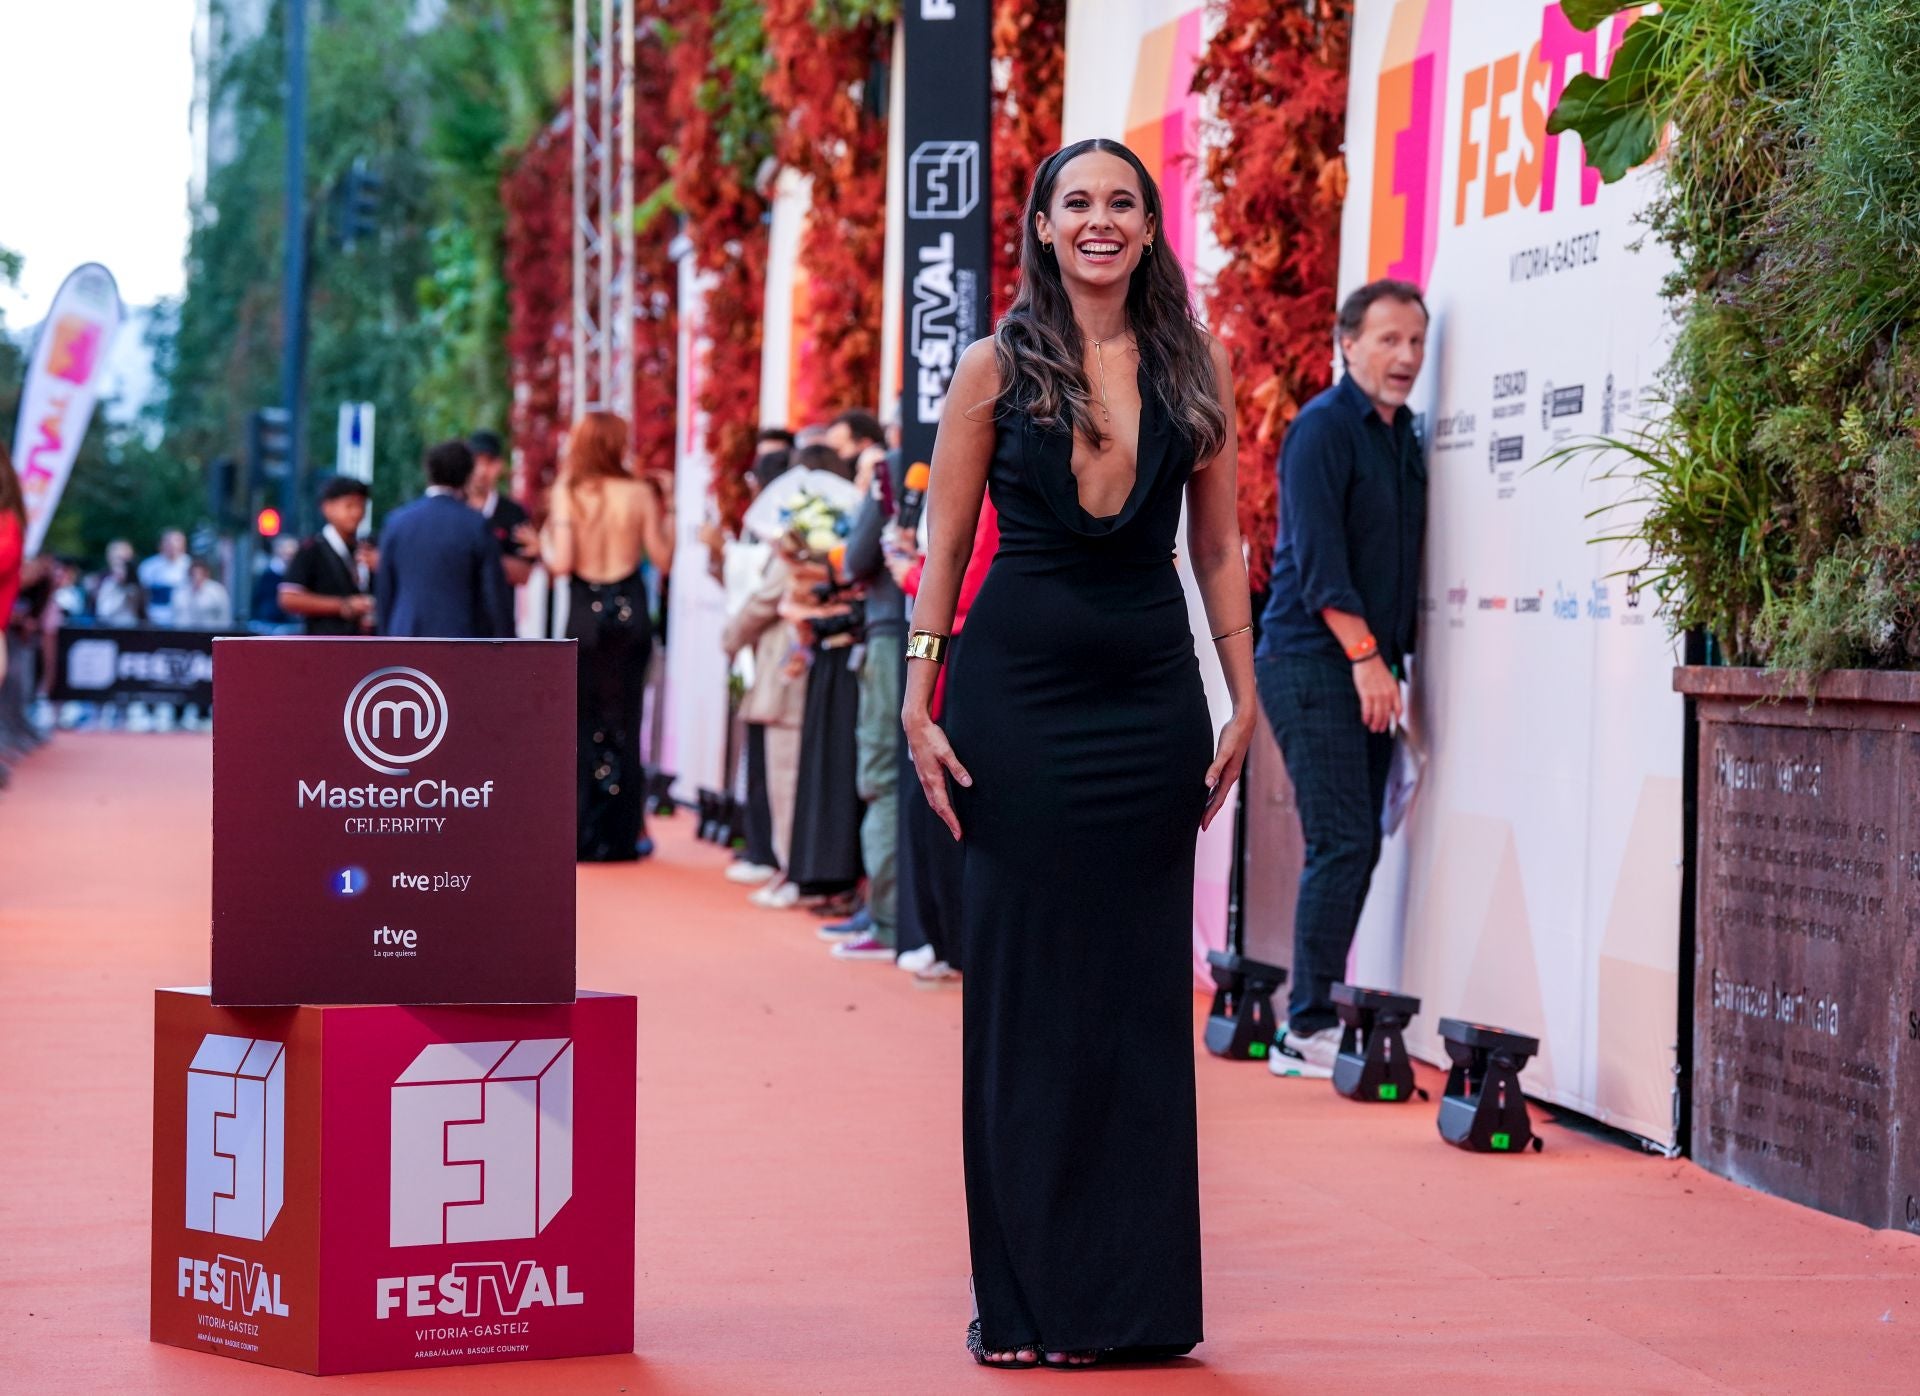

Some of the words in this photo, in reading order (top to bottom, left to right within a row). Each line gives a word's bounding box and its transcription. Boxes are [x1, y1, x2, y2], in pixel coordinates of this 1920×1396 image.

[298, 779, 494, 809] MasterChef
[344, 817, 447, 834] CELEBRITY
[341, 869, 354, 893] 1
[391, 872, 430, 891] rtve
[433, 871, 472, 891] play
[373, 925, 418, 948] rtve
[373, 949, 381, 957] La
[382, 950, 394, 958] que
[394, 949, 417, 958] quieres
[178, 1253, 289, 1318] FESTVAL
[376, 1259, 584, 1320] FESTVAL
[197, 1314, 260, 1337] VITORIA-GASTEIZ
[415, 1322, 530, 1341] VITORIA-GASTEIZ
[467, 1345, 495, 1355] BASQUE
[496, 1344, 530, 1354] COUNTRY
